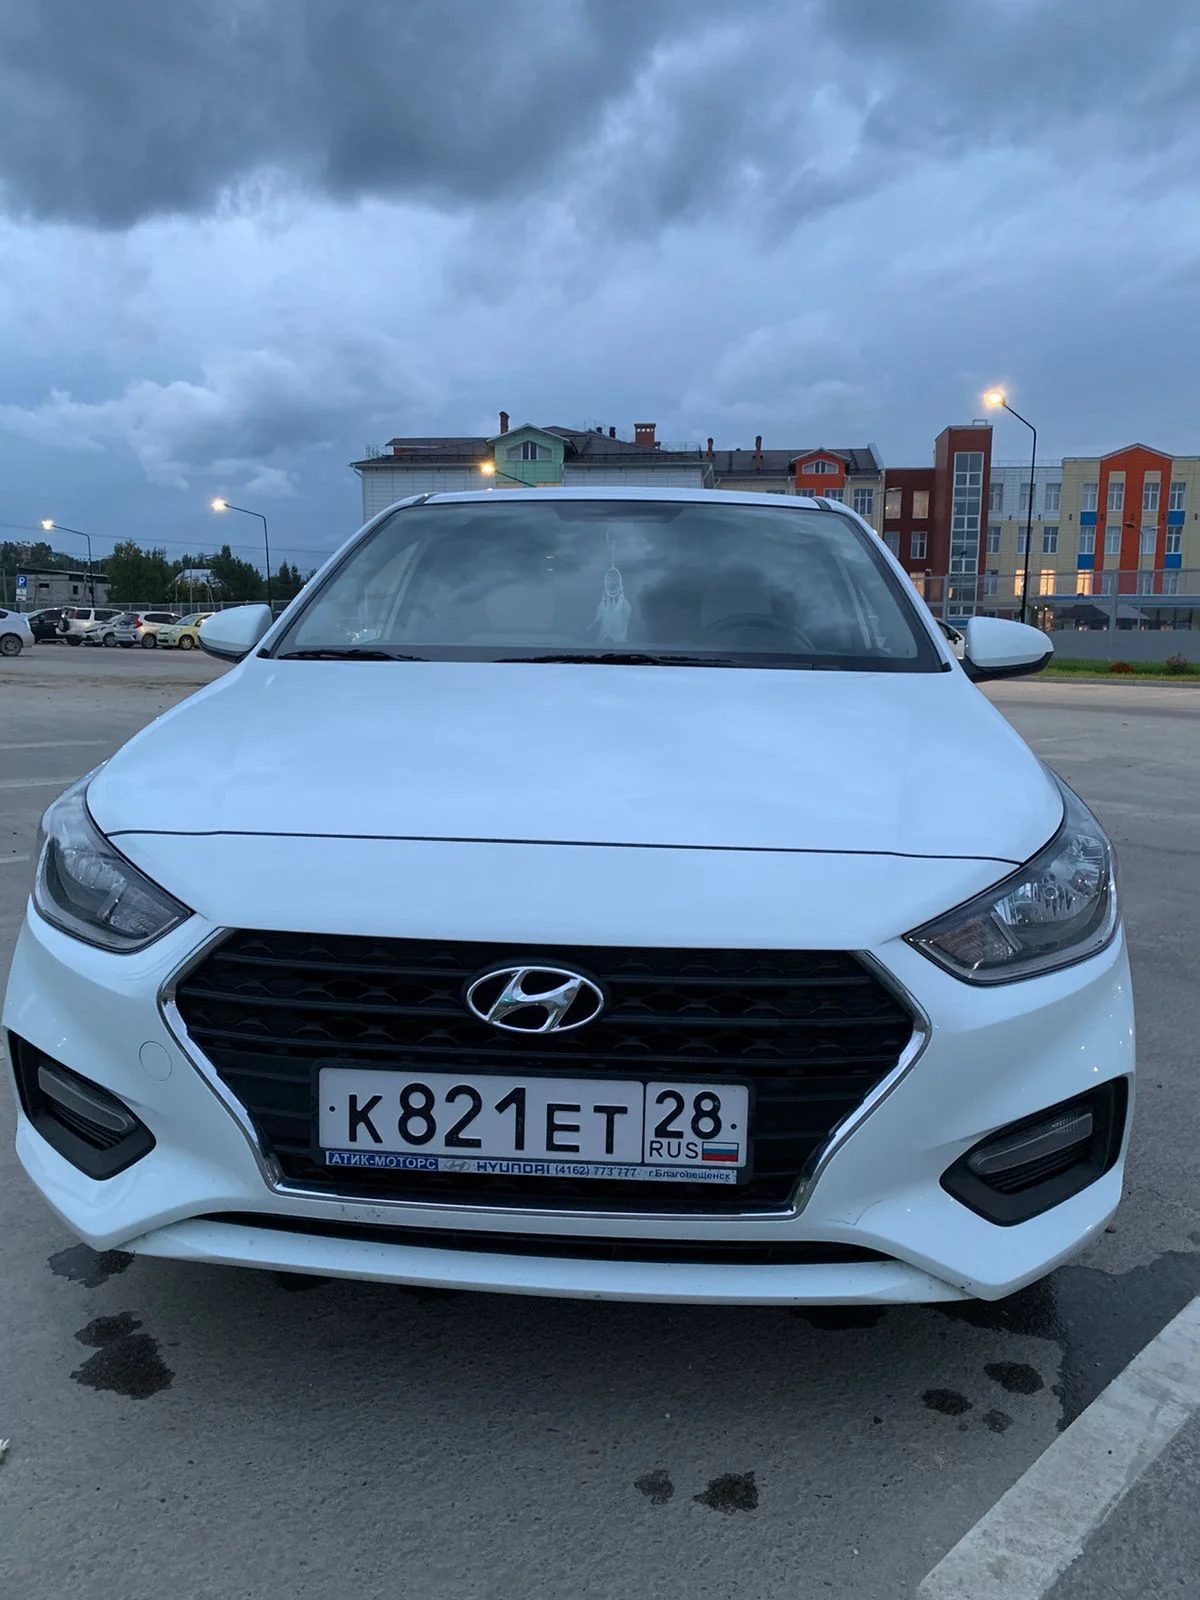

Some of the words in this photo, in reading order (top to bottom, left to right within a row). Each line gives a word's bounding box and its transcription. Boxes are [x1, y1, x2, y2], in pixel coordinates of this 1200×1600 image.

[654, 1089, 722, 1140] 28
[649, 1140, 699, 1159] RUS
[331, 1153, 436, 1170] АТИК-МОТОРС
[476, 1161, 550, 1175] HYUNDAI
[555, 1164, 590, 1177] (4162)
